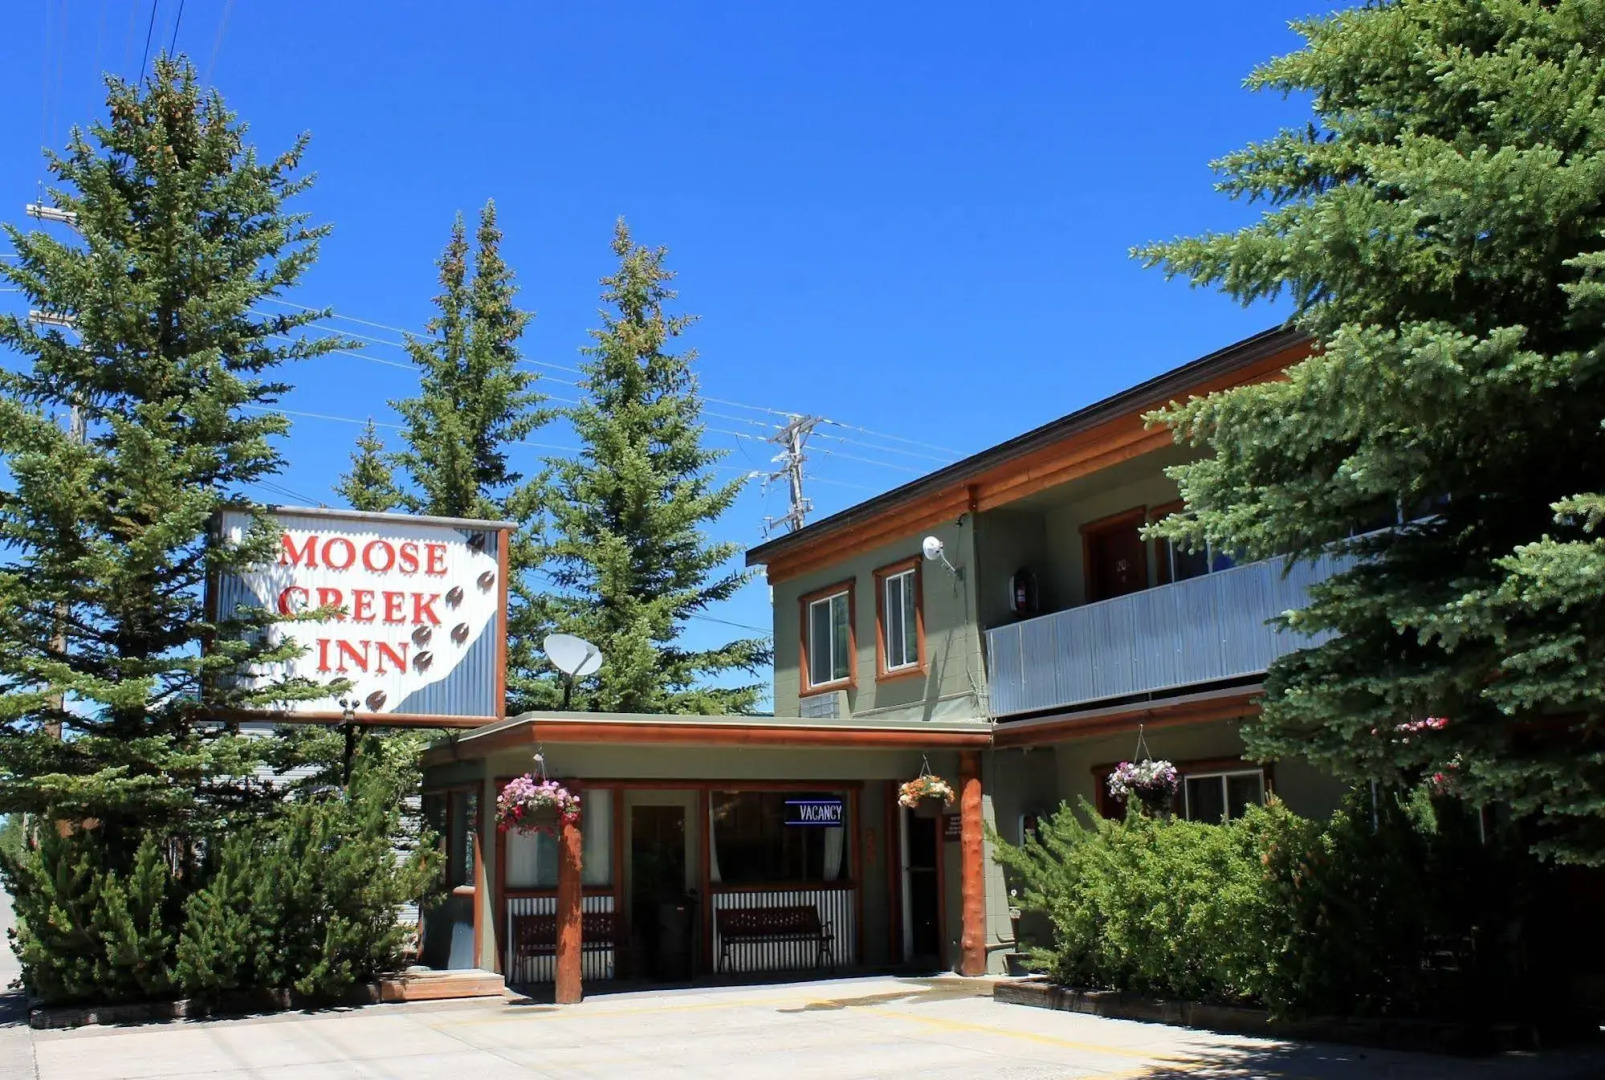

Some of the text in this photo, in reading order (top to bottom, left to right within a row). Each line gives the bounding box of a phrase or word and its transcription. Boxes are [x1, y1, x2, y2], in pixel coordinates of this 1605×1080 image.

[280, 534, 448, 575] MOOSE
[278, 586, 442, 625] CREEK
[316, 638, 410, 674] INN
[800, 805, 842, 820] VACANCY
